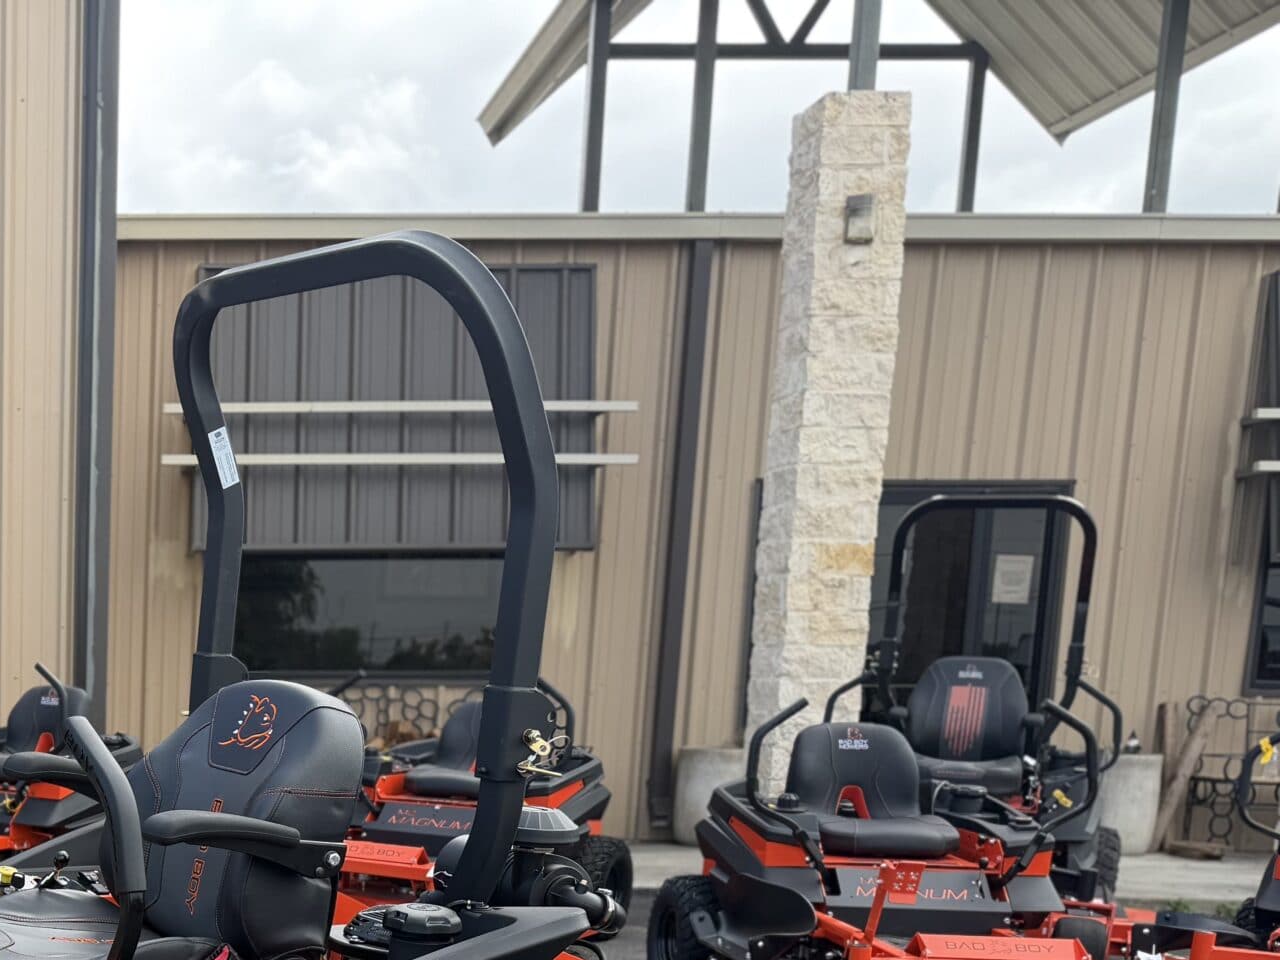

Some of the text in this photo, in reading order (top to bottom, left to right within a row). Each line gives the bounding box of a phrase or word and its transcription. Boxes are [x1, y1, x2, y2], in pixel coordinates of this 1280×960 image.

[387, 815, 472, 831] MAGNUM
[856, 885, 969, 901] MNUM
[944, 940, 1055, 953] BAD BOY
